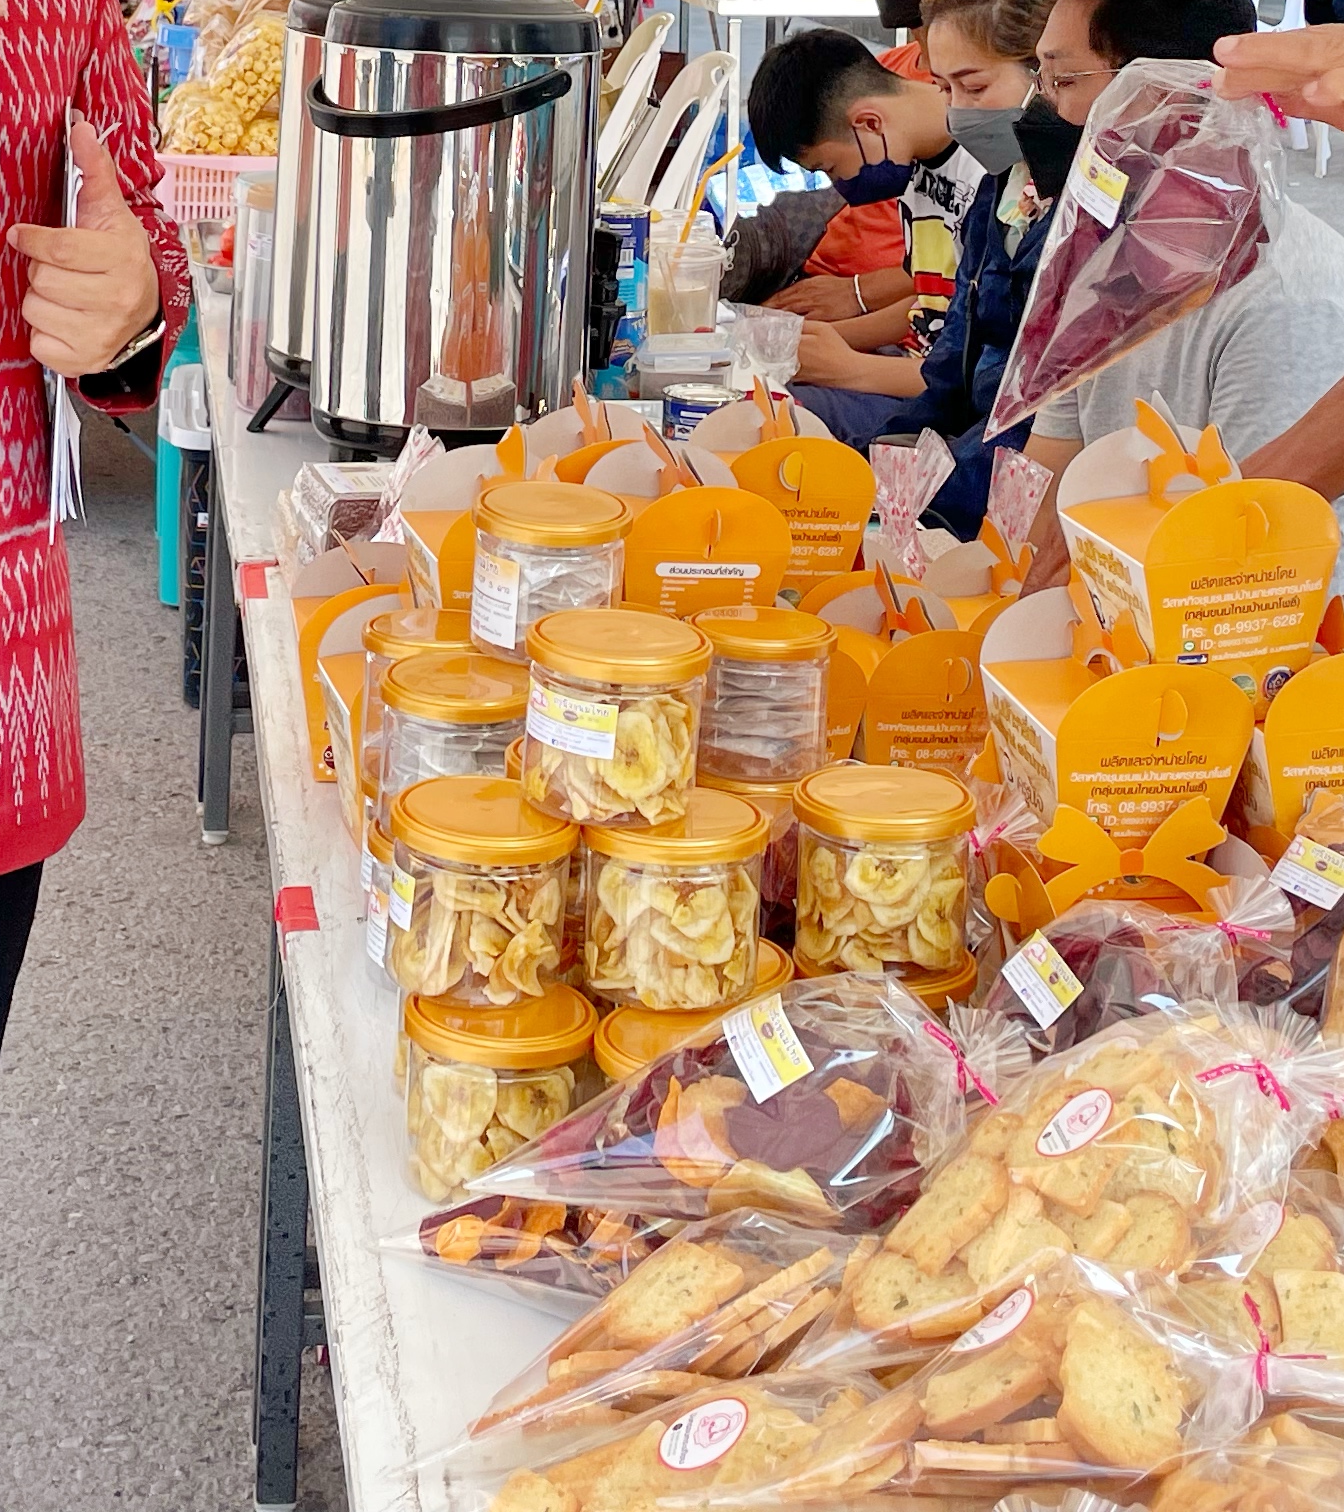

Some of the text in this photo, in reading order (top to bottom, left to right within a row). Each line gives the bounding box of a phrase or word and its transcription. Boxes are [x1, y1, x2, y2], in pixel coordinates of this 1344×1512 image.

[1190, 565, 1297, 590] ผลิตและจำหน่ายโดย
[1213, 612, 1305, 637] 08-9937-6287
[1100, 751, 1207, 767] ผลิตและจำหน่ายโดย
